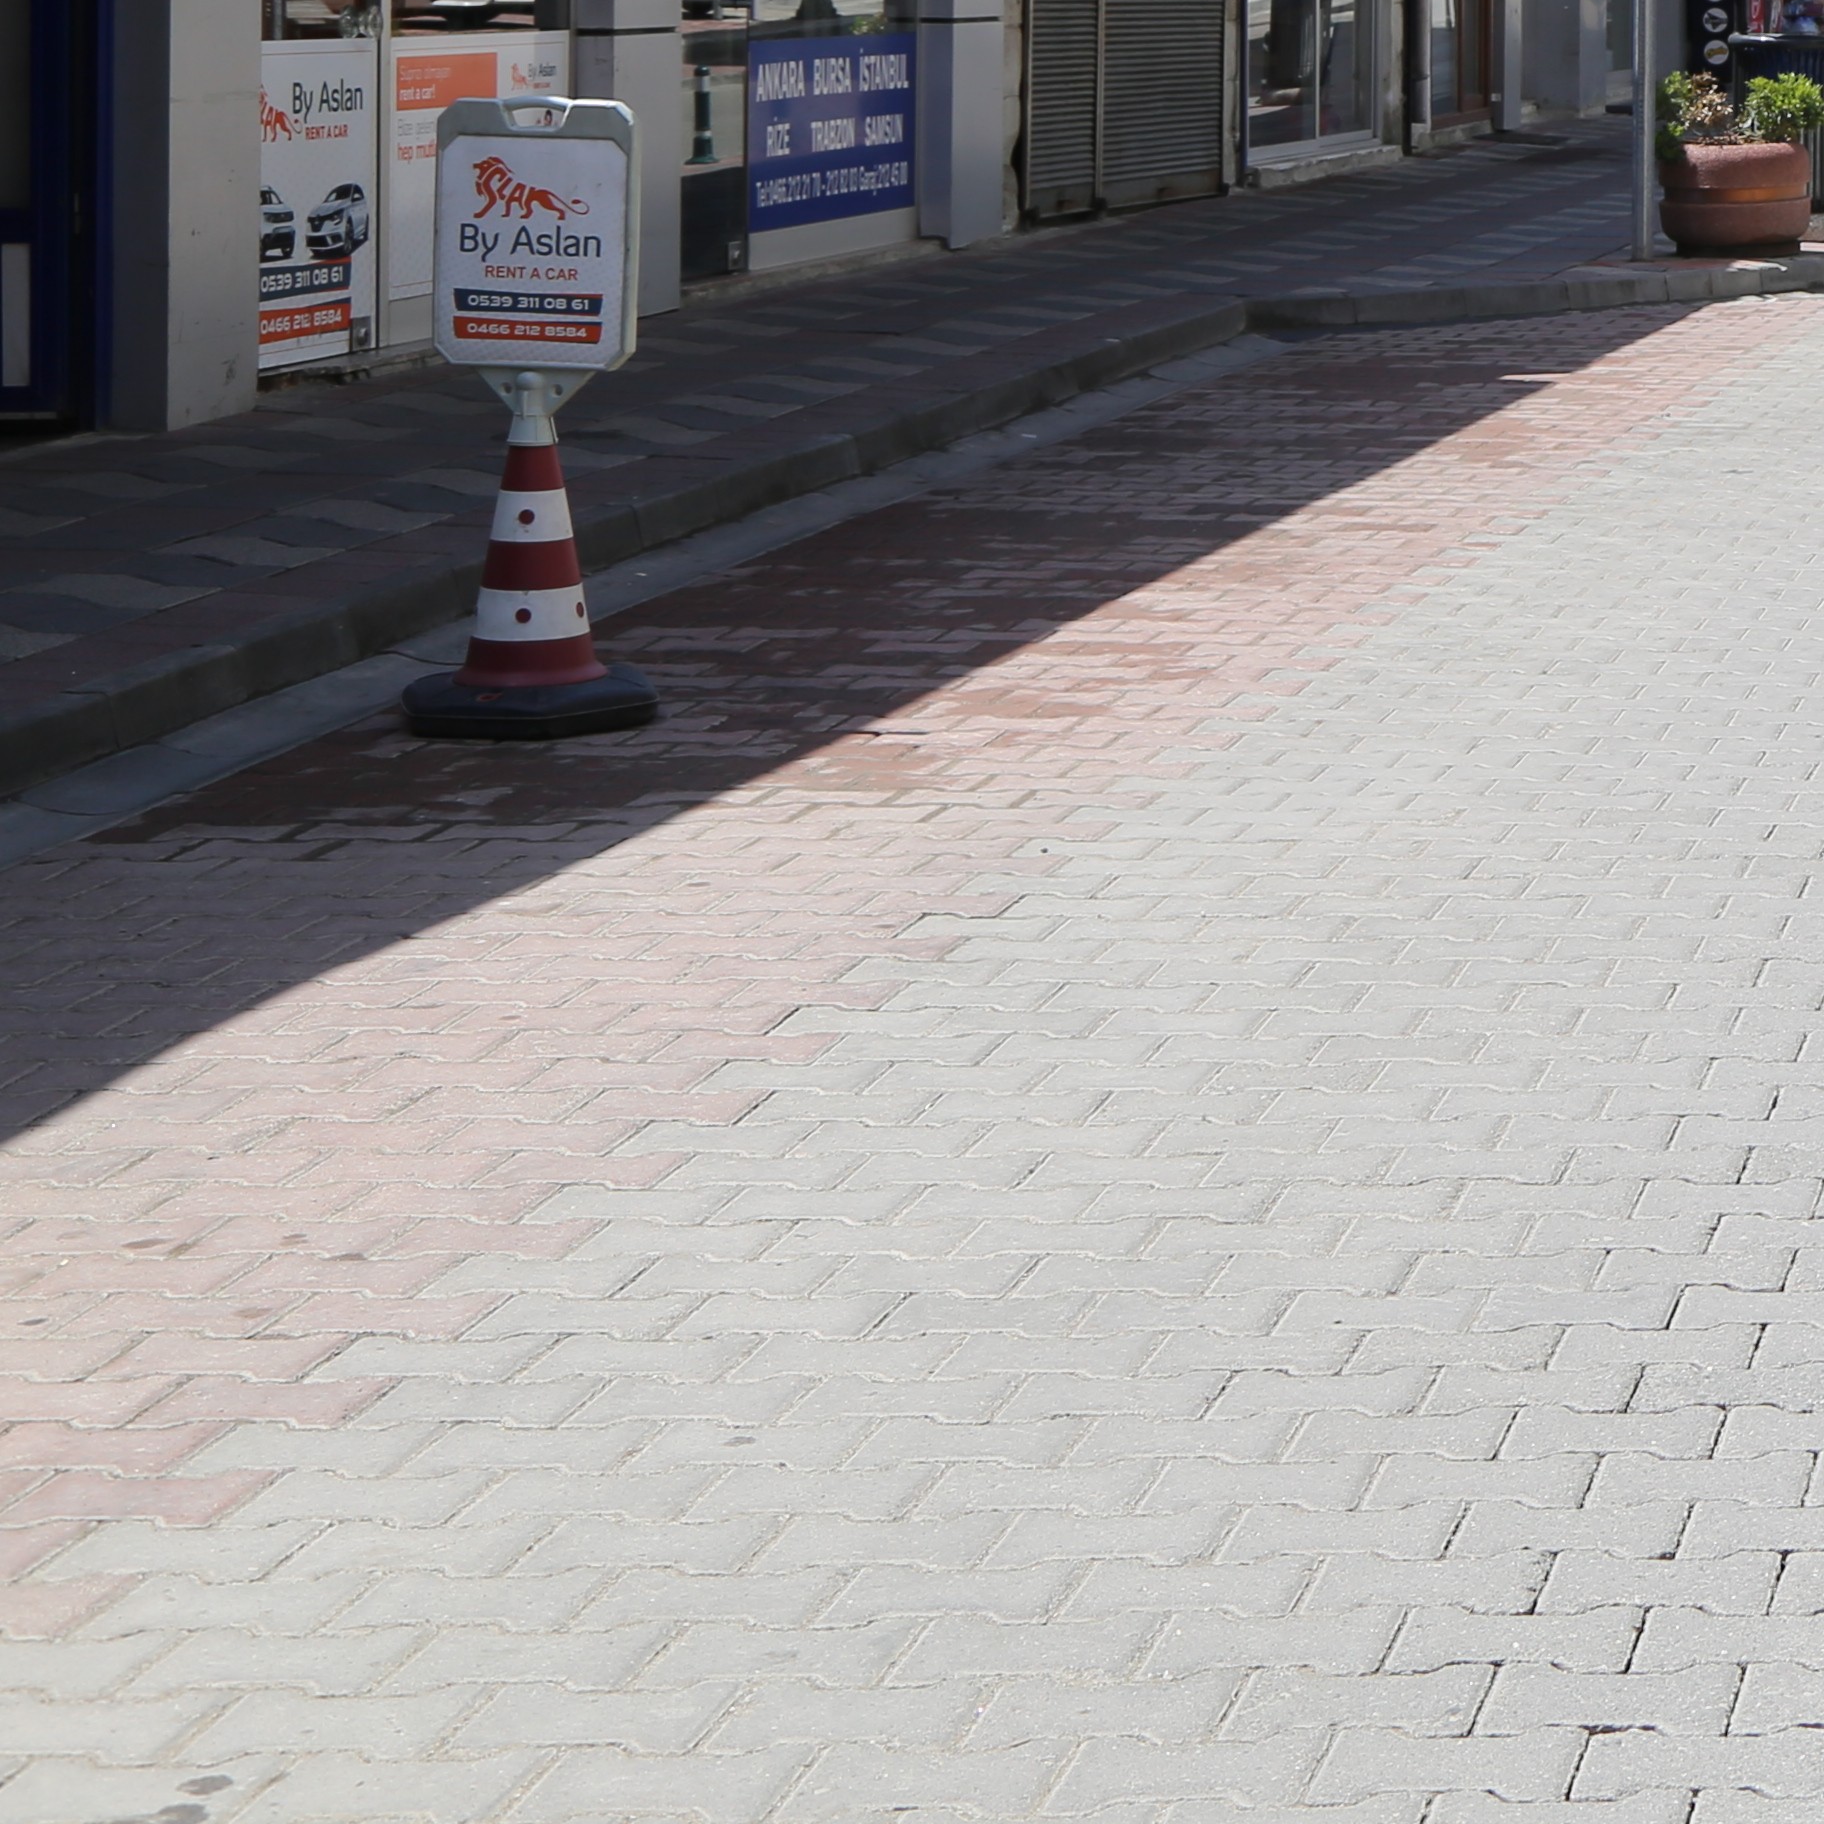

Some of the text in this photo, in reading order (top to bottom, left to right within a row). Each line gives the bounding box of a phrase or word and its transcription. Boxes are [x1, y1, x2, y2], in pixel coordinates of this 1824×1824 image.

[756, 48, 909, 103] ANKARA BURSA İSTANBUL
[292, 77, 364, 124] By Aslan
[305, 125, 326, 141] RENT
[333, 123, 349, 138] CAR
[765, 113, 904, 158] RİZE TRABZON SAMSUN
[459, 222, 602, 263] By Aslan
[260, 265, 344, 293] 0539 311 08 61
[485, 265, 578, 281] RENT A CAR
[467, 294, 590, 310] 0539 311 08 61
[260, 313, 292, 336] 0466
[313, 308, 342, 327] 8584
[467, 322, 588, 337] 0466 212 8584
